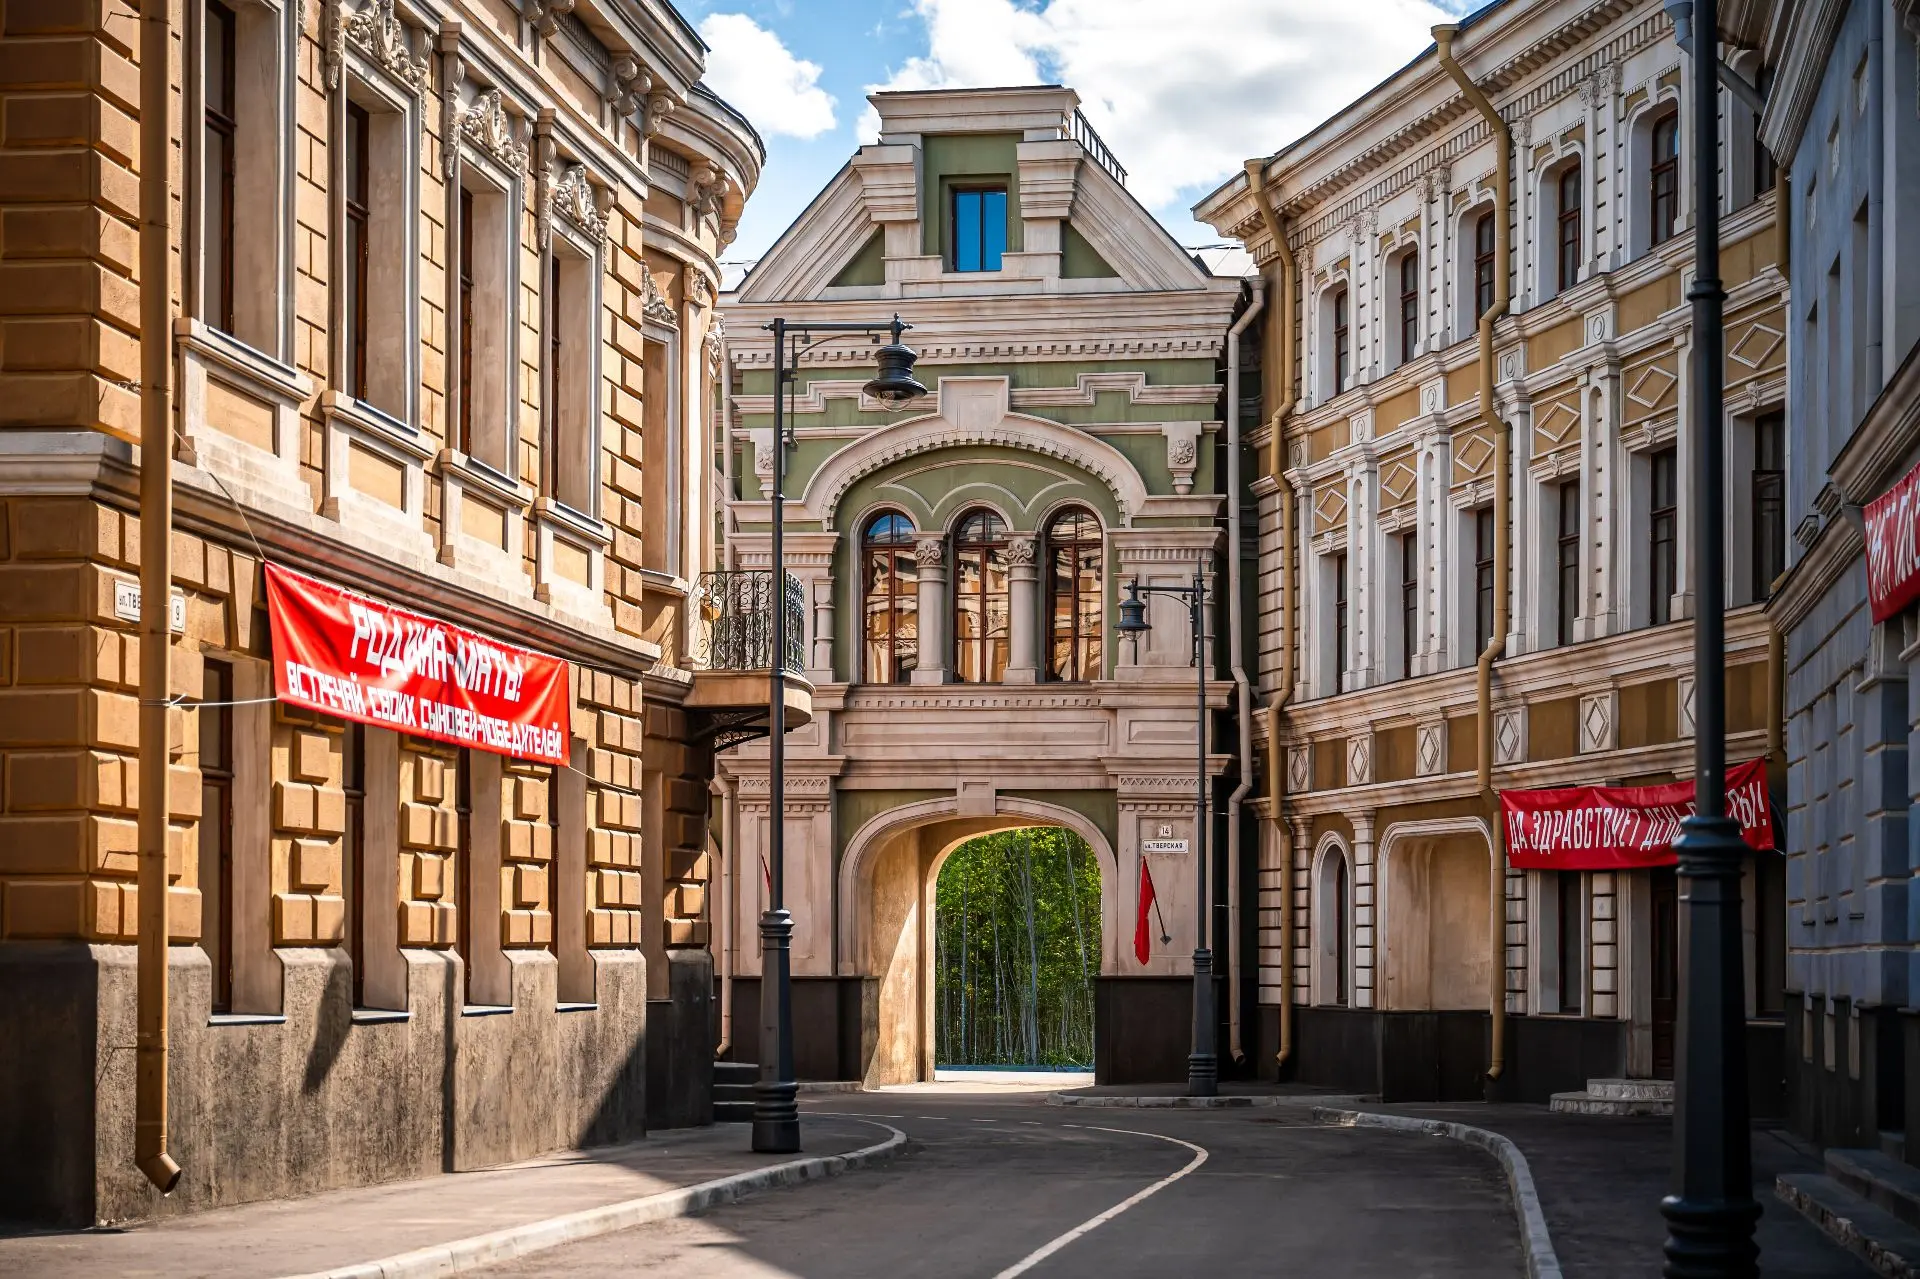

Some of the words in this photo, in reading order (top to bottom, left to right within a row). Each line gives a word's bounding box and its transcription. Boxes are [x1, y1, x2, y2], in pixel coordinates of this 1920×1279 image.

[175, 605, 180, 621] 9
[348, 602, 523, 702] РОДИНА-МАТЬ!
[286, 659, 366, 716] ВСТРЕЧАЙ
[367, 685, 417, 727] СВОИХ
[419, 697, 562, 758] СЫНОВЕЙ-ПОБЕДИТЕЛЕЙ!
[1162, 827, 1169, 835] 14
[1507, 810, 1528, 853] ДА
[1530, 807, 1640, 854] ЗДРАВСТВУЕТ
